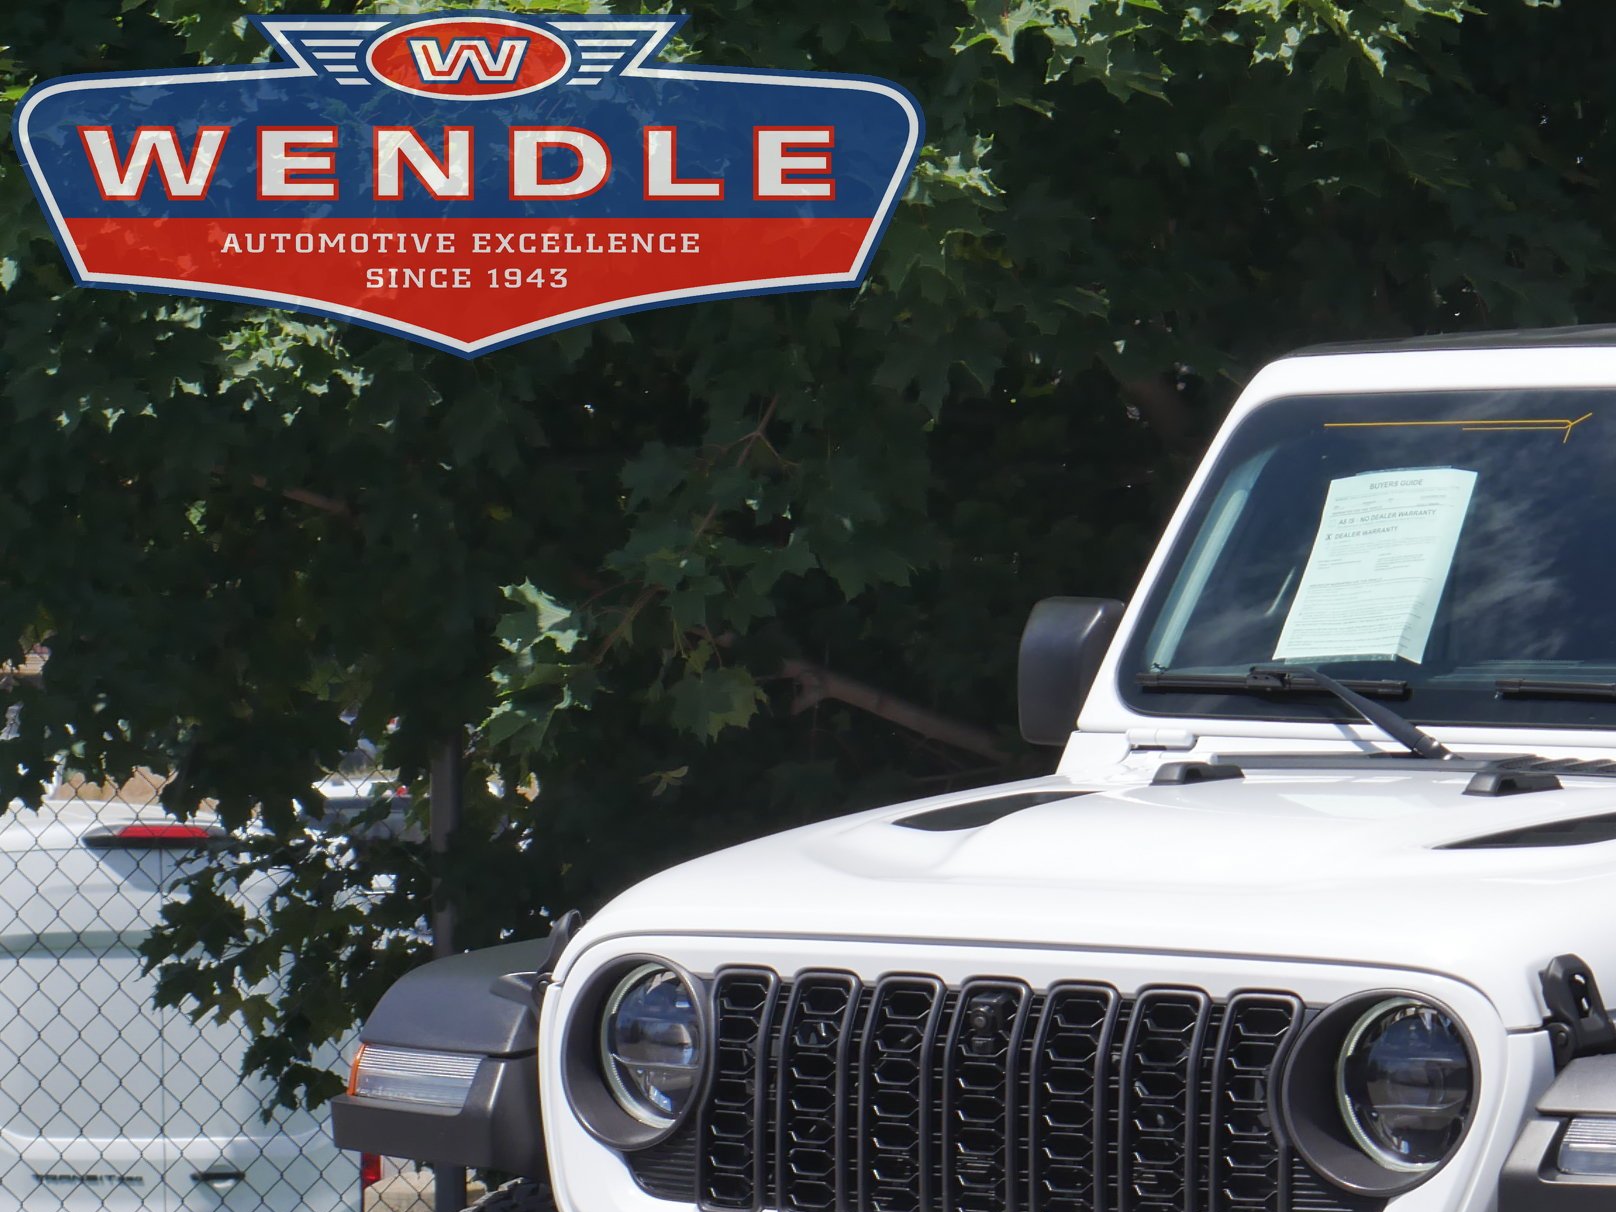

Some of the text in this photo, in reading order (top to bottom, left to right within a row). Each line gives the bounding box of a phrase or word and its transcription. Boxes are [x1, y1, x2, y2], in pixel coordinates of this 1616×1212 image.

[1369, 479, 1424, 490] BUYERS GUIDE
[1370, 511, 1397, 521] DEALER
[1398, 509, 1437, 518] WARRANTY
[1334, 530, 1361, 540] DEALER
[1362, 526, 1398, 536] WARRANTY
